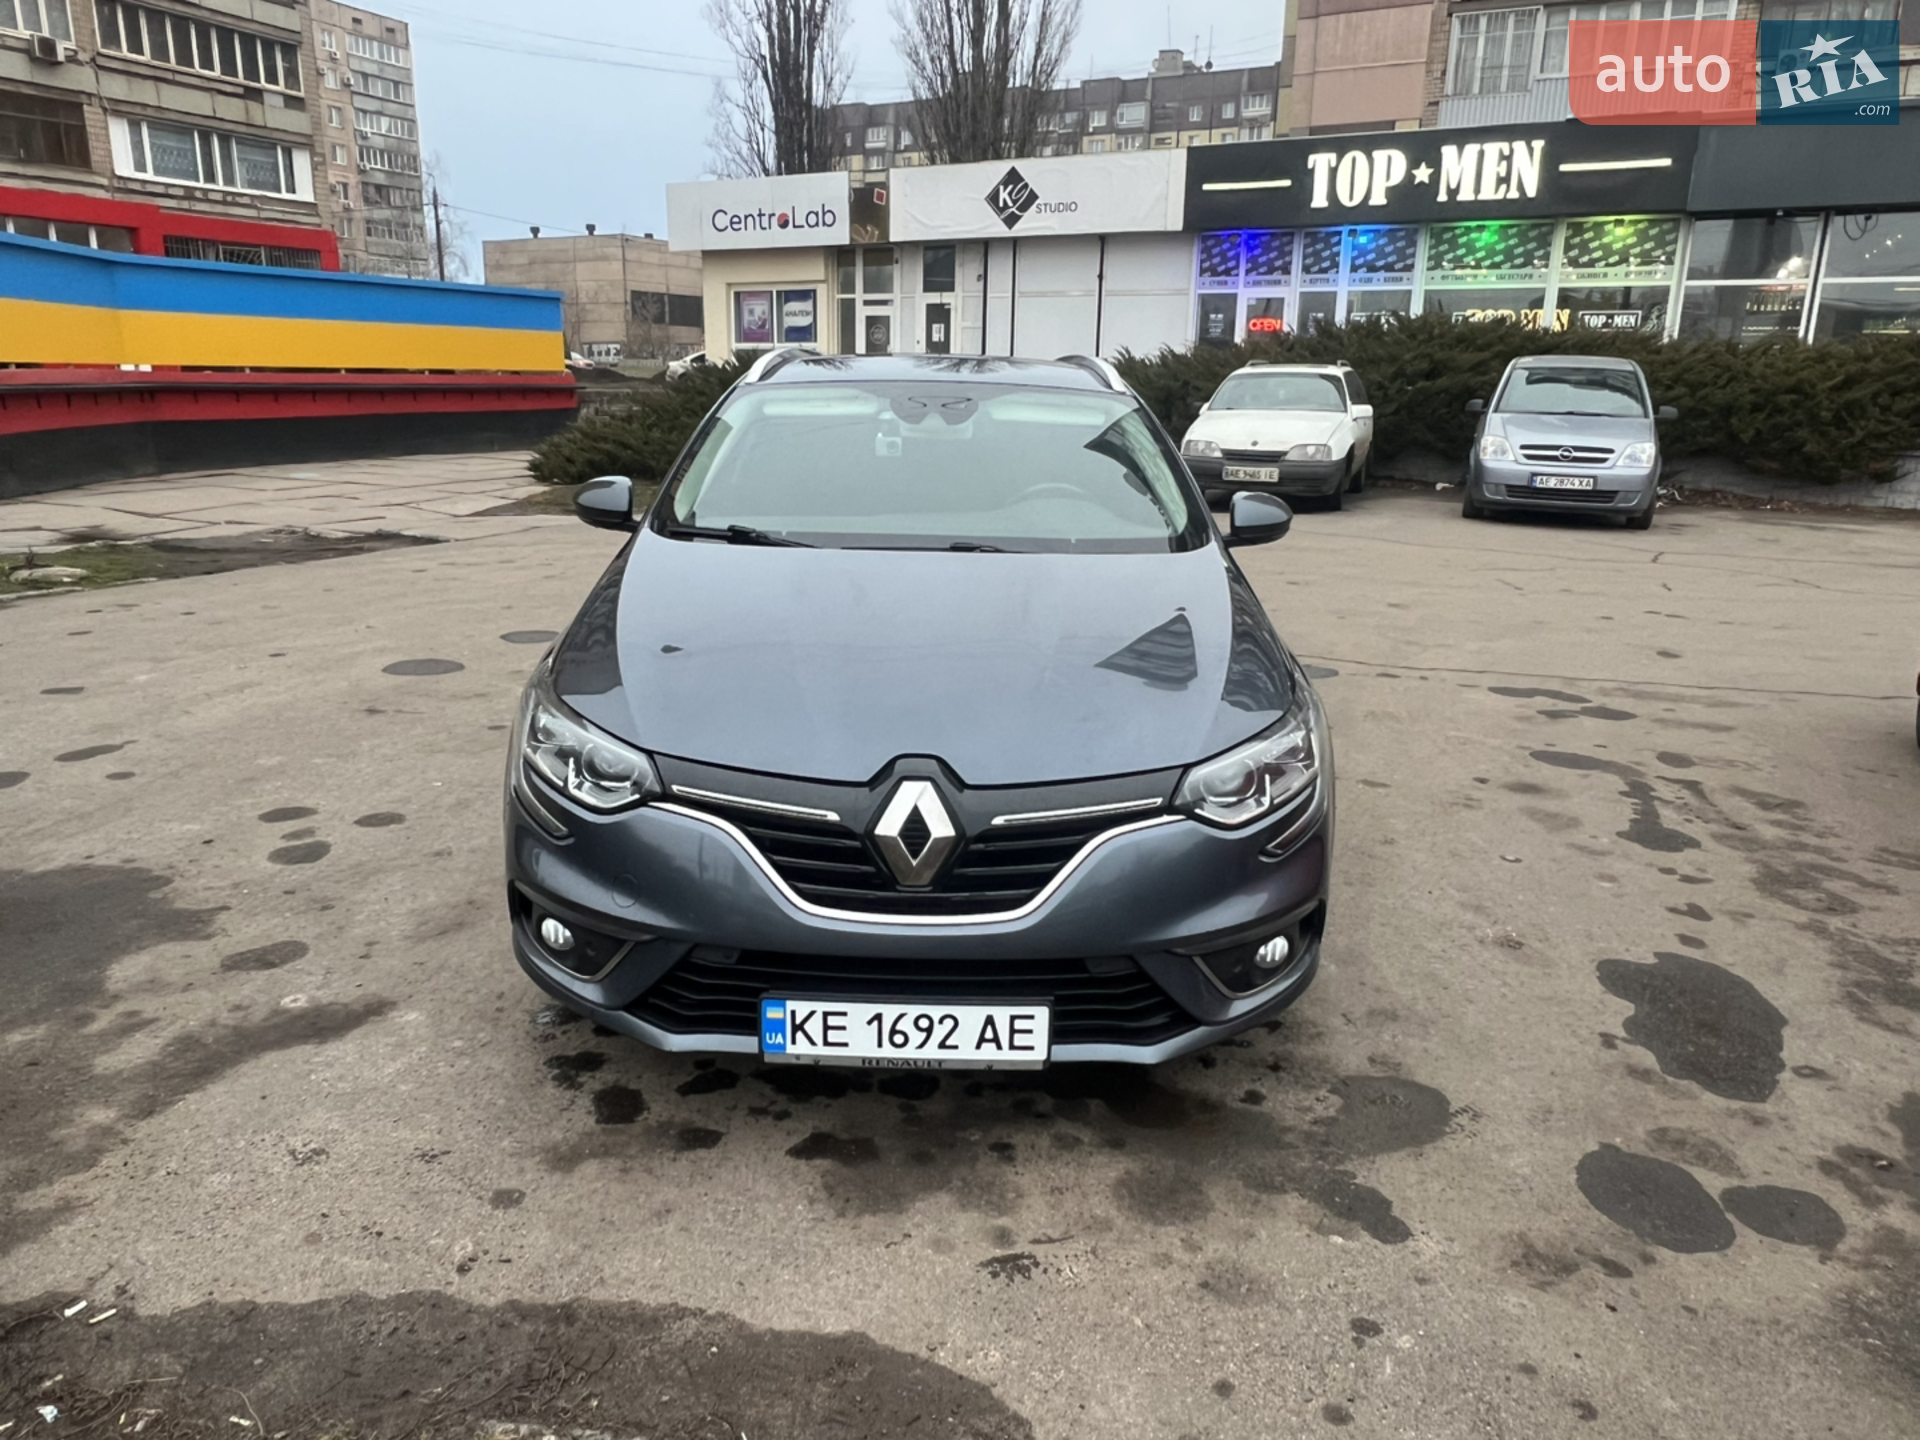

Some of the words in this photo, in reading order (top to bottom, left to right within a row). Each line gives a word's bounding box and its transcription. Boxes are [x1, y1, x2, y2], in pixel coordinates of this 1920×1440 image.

[1307, 148, 1407, 208] TOP
[1436, 139, 1546, 202] MEN
[1035, 200, 1078, 214] STUDIO
[711, 203, 837, 233] CentroLab
[1249, 317, 1281, 332] OPEN
[1583, 314, 1603, 328] TOP
[1612, 314, 1637, 328] MEN
[1538, 477, 1551, 487] AE
[1553, 478, 1576, 488] 2874
[1577, 478, 1592, 488] XA
[789, 1009, 849, 1048] KE
[865, 1012, 960, 1051] 1692
[975, 1014, 1036, 1052] AE
[766, 1032, 784, 1045] UA
[861, 1058, 946, 1069] RENAULT
